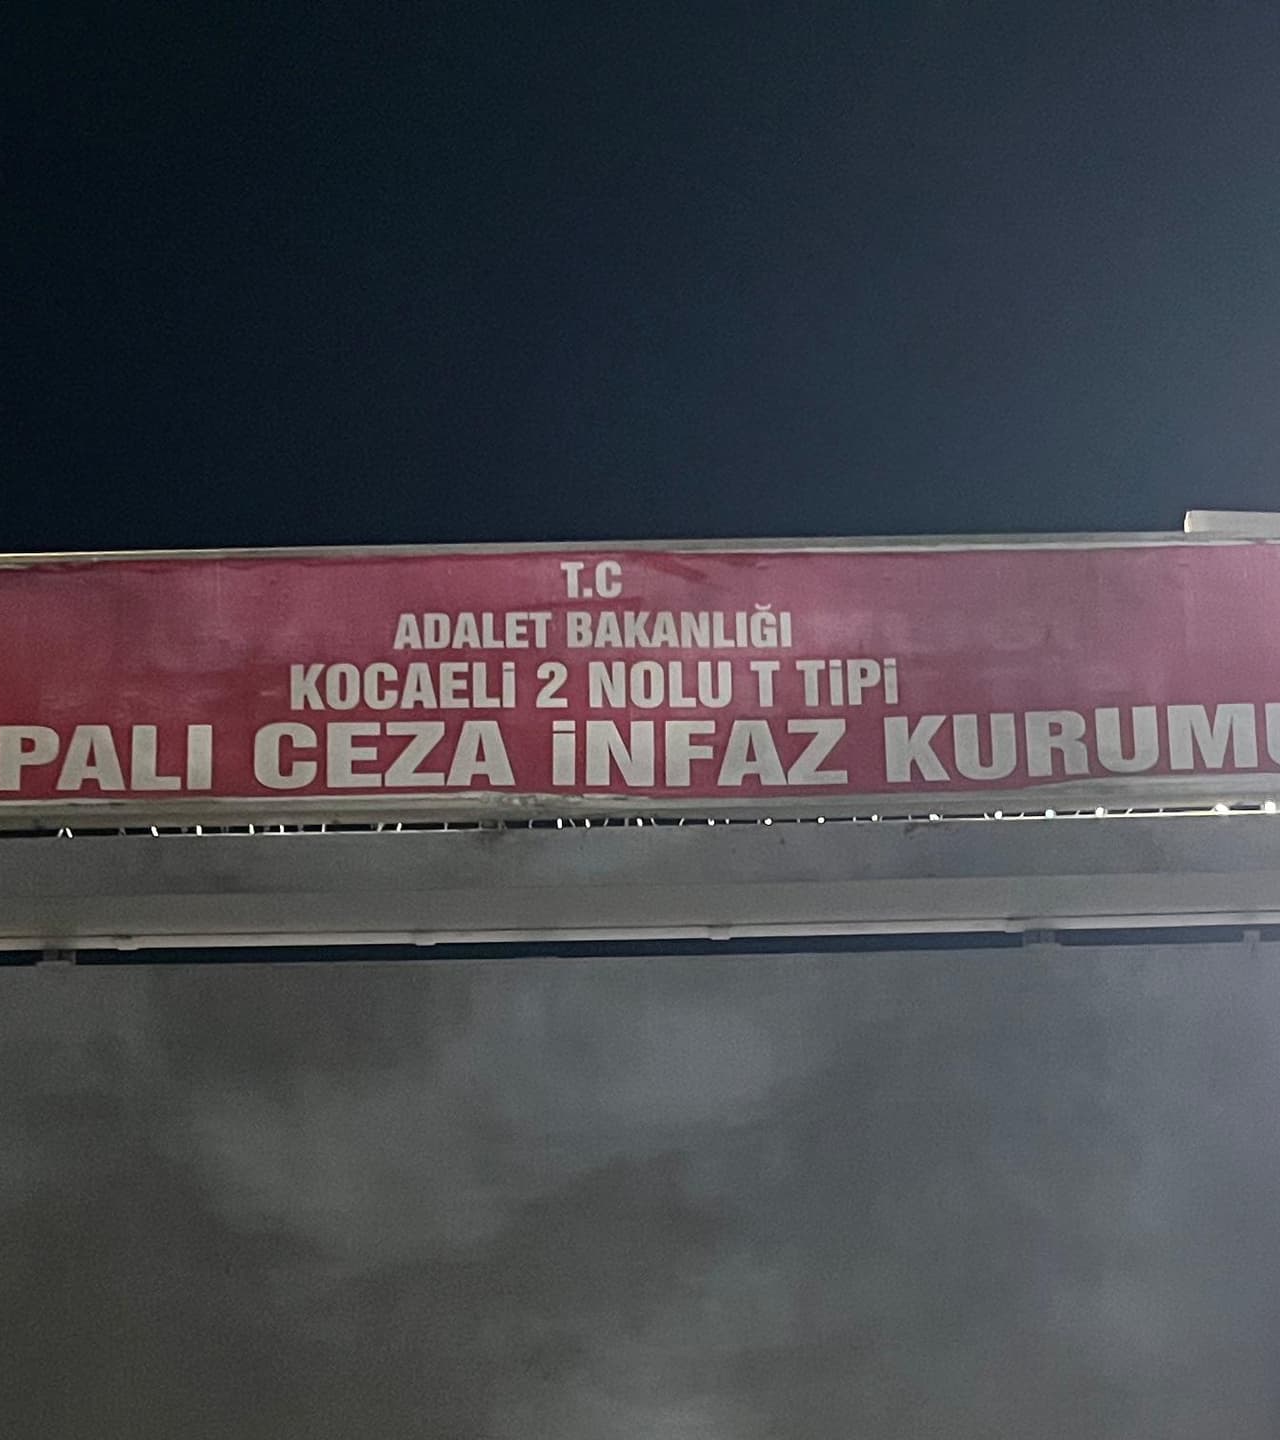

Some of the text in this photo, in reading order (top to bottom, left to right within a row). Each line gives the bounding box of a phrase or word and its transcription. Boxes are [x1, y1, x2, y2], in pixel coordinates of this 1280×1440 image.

[560, 560, 623, 599] T.C
[393, 603, 793, 650] ADALET BAKANLIĞI
[536, 662, 569, 709] 2
[588, 660, 732, 709] NOLU
[750, 660, 781, 708] T
[253, 720, 516, 791] CEZA
